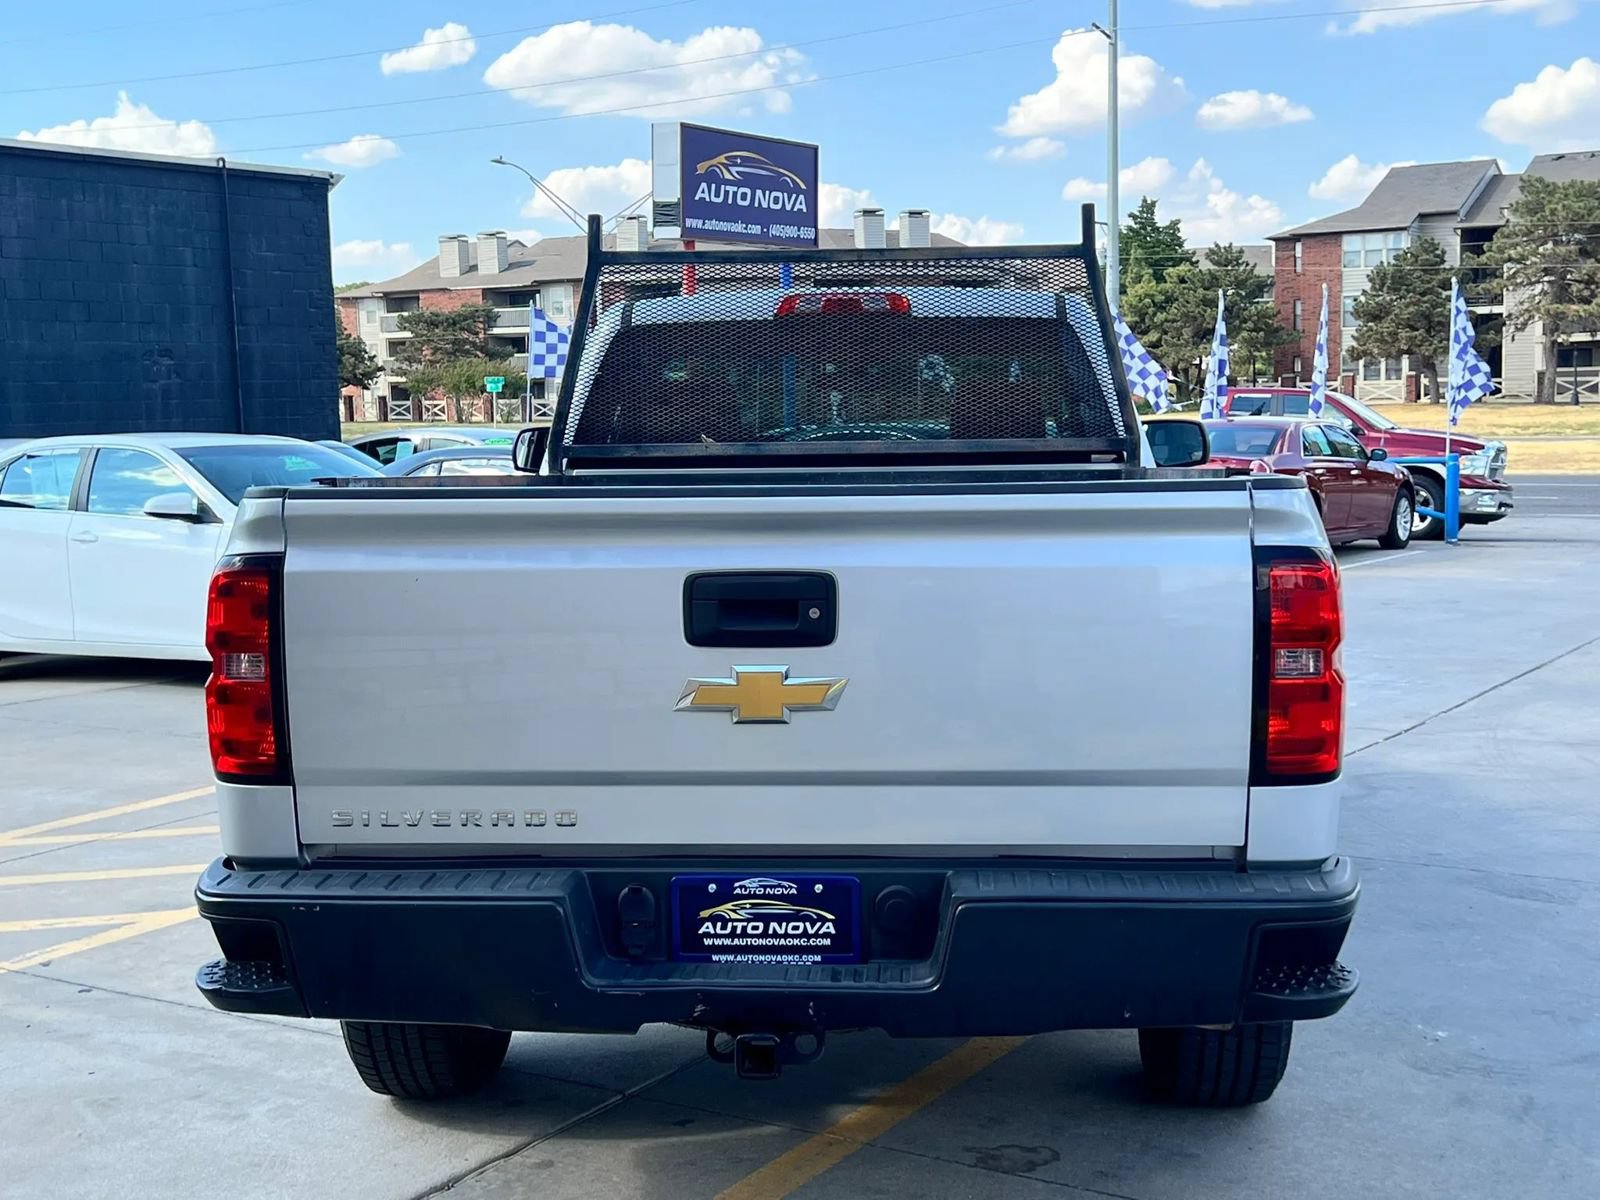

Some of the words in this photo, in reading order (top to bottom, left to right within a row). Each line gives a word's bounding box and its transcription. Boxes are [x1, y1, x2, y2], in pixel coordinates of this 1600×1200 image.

[694, 182, 752, 207] AUTO
[754, 188, 808, 213] NOVA
[685, 217, 762, 235] www.autonovaokc.com
[332, 809, 578, 827] SILVERADO
[733, 887, 765, 895] AUTO
[765, 887, 798, 895] NOVA
[698, 921, 765, 934] AUTO
[768, 921, 836, 934] NOVA
[703, 938, 831, 946] WWW.AUTONOVAOKC.COM
[711, 954, 822, 962] WWW.AUTONOVAOKC.COM
